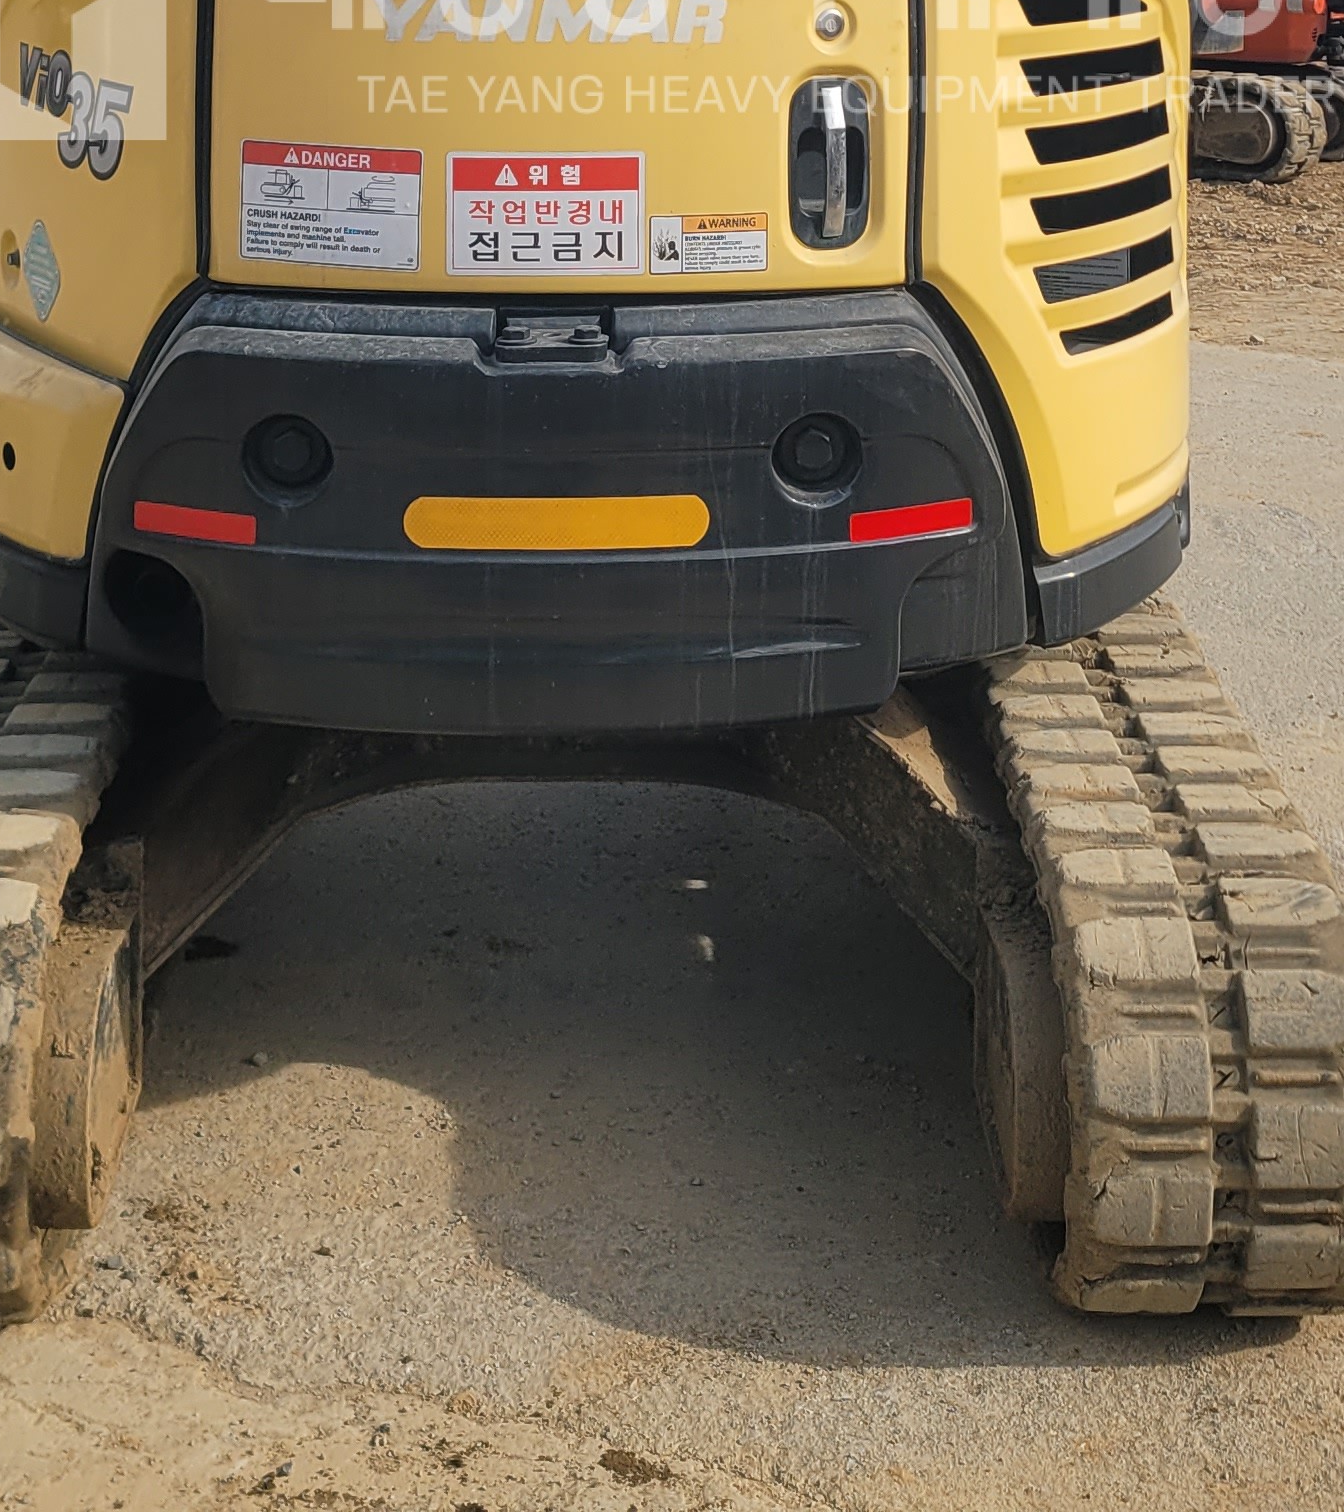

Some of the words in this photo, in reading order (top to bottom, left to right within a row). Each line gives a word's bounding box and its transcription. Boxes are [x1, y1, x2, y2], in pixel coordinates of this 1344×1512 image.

[301, 150, 371, 169] DANGER
[247, 208, 278, 219] CRUSH
[280, 211, 321, 222] HAZARD!
[468, 199, 624, 225] 작업반경내
[247, 219, 261, 228] Stay
[263, 221, 279, 229] clear
[290, 224, 311, 233] swing
[312, 226, 333, 234] range
[334, 226, 342, 234] of
[343, 227, 379, 236] Excavator
[707, 217, 757, 228] WARNING
[246, 237, 269, 245] Failure
[279, 240, 304, 249] comply
[306, 241, 318, 249] will
[319, 243, 340, 251] result
[350, 245, 371, 253] death
[287, 232, 300, 240] and
[302, 233, 331, 242] machine
[468, 230, 624, 263] 접근금지
